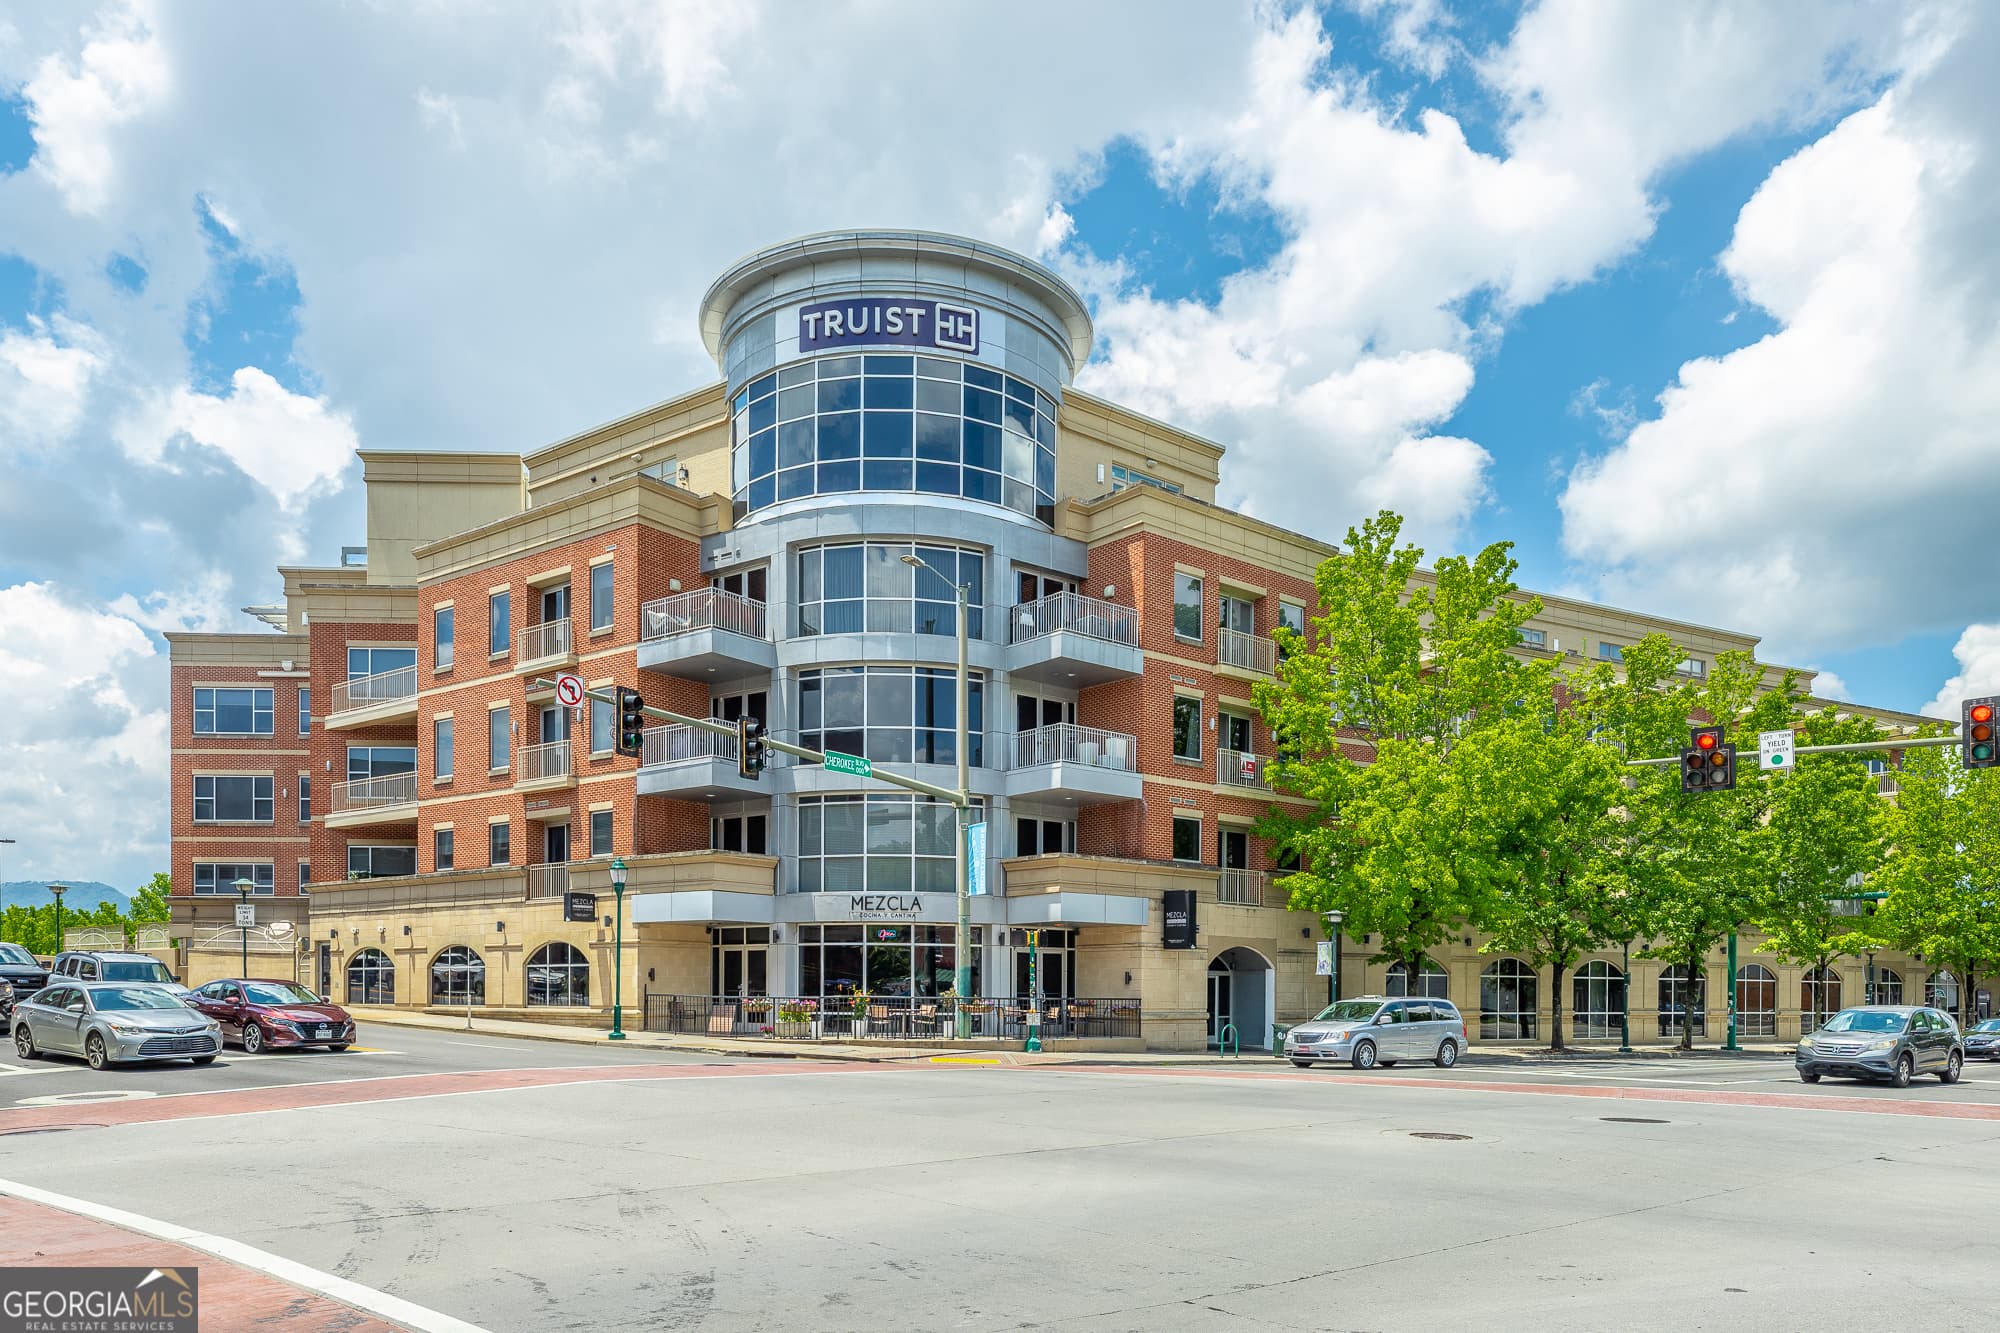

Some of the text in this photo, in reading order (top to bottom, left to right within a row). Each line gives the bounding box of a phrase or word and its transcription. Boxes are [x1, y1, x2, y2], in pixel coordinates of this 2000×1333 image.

[802, 306, 926, 340] TRUIST
[826, 755, 855, 770] CHEROKEE
[851, 895, 922, 911] MEZCLA
[1166, 911, 1187, 919] MEZCLA
